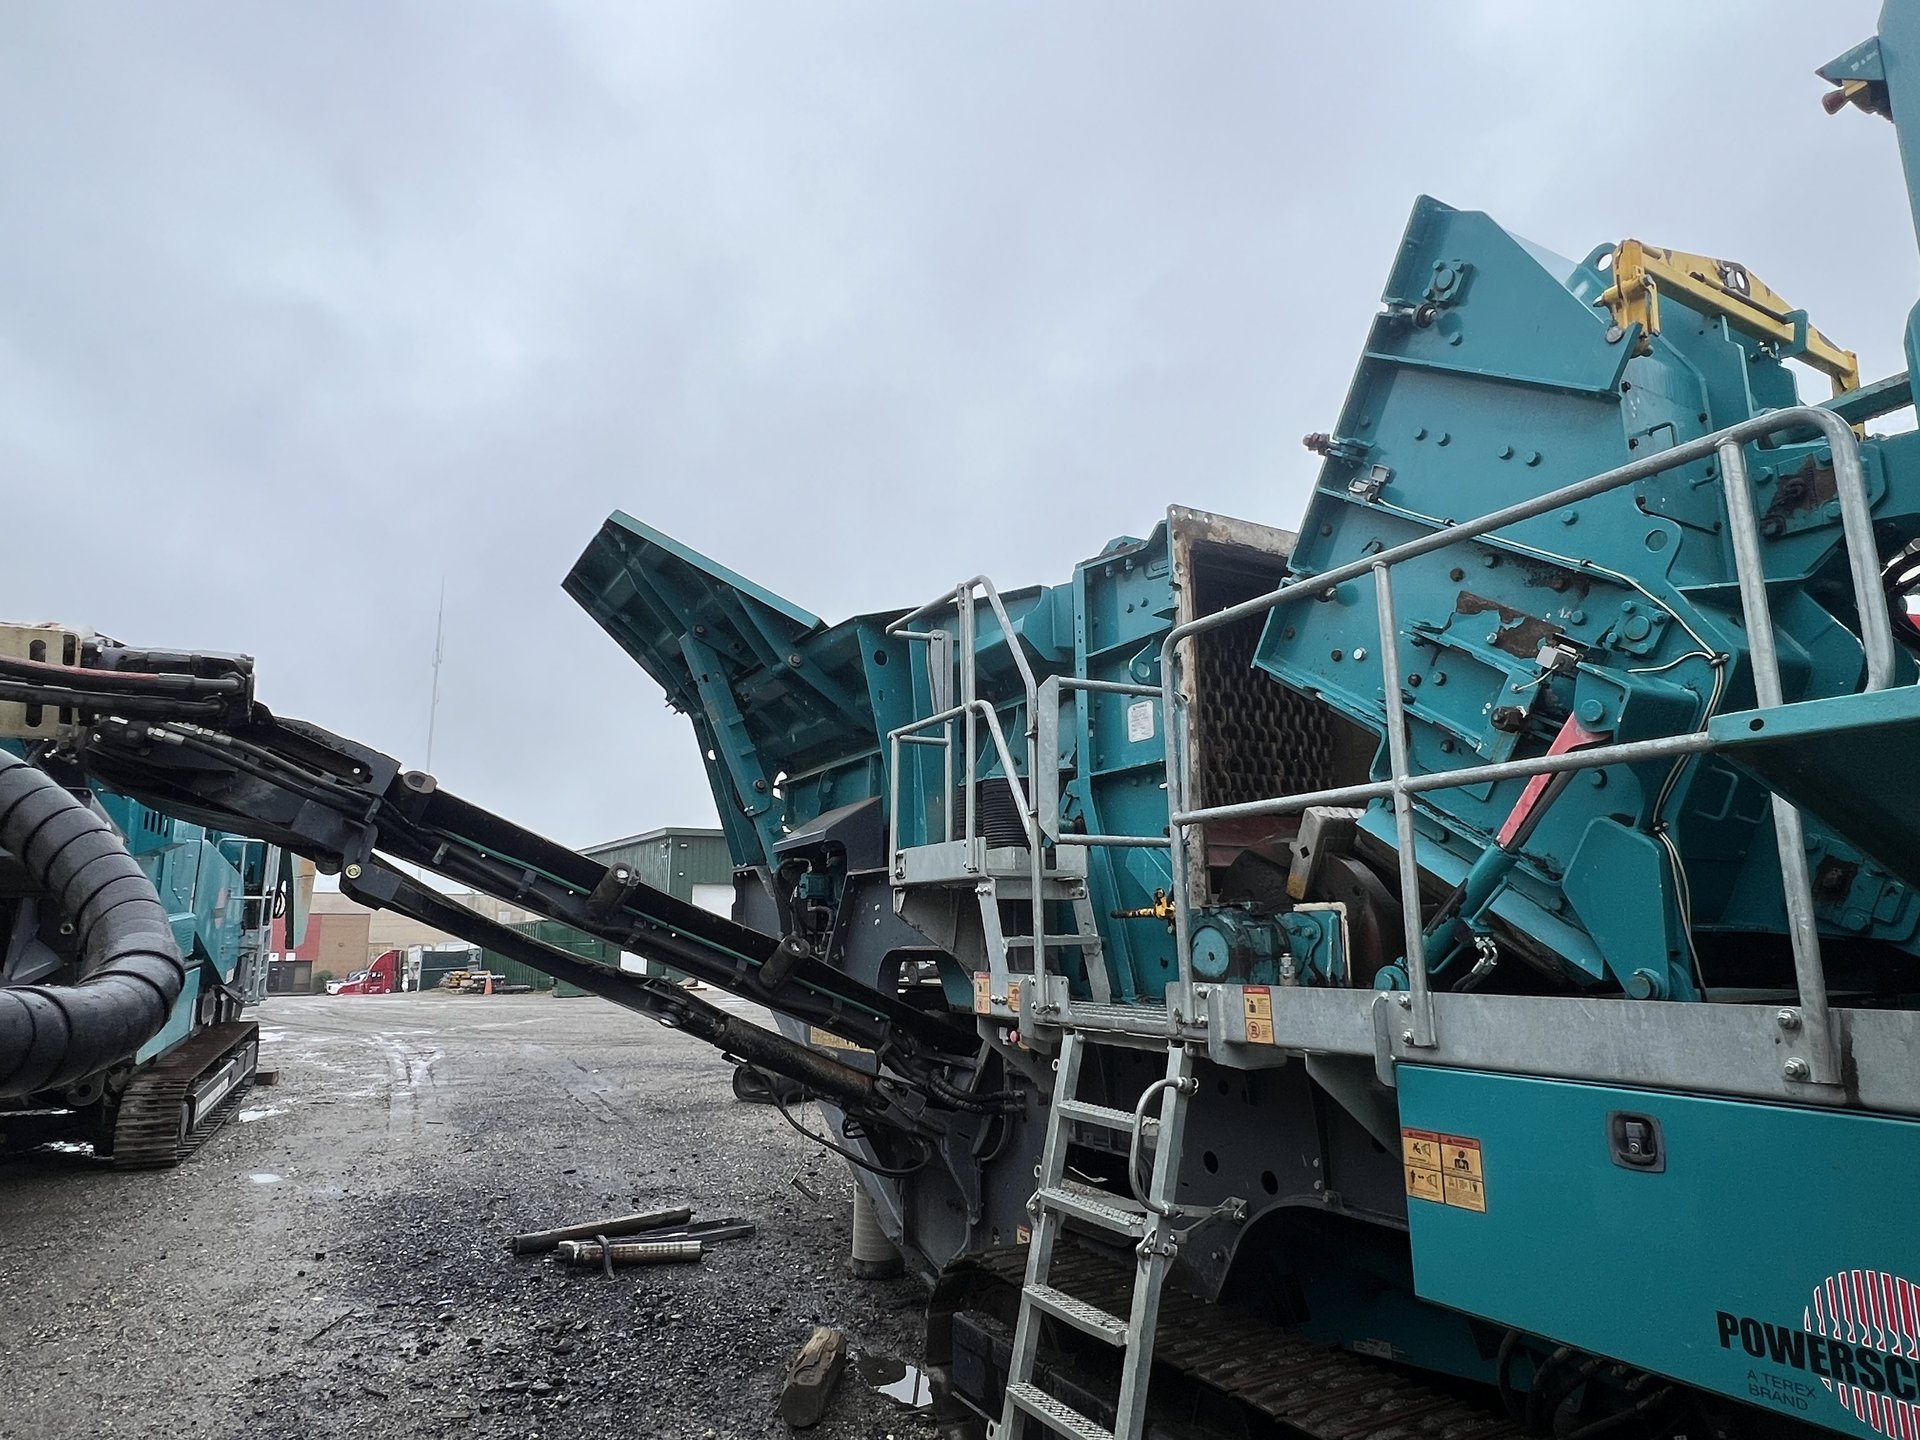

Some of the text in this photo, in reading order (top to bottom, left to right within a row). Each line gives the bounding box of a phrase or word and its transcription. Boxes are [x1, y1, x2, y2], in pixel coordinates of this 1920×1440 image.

[1716, 1310, 1920, 1402] POWERSC
[1747, 1369, 1816, 1400] A TEREX
[1749, 1383, 1808, 1410] BRAND
